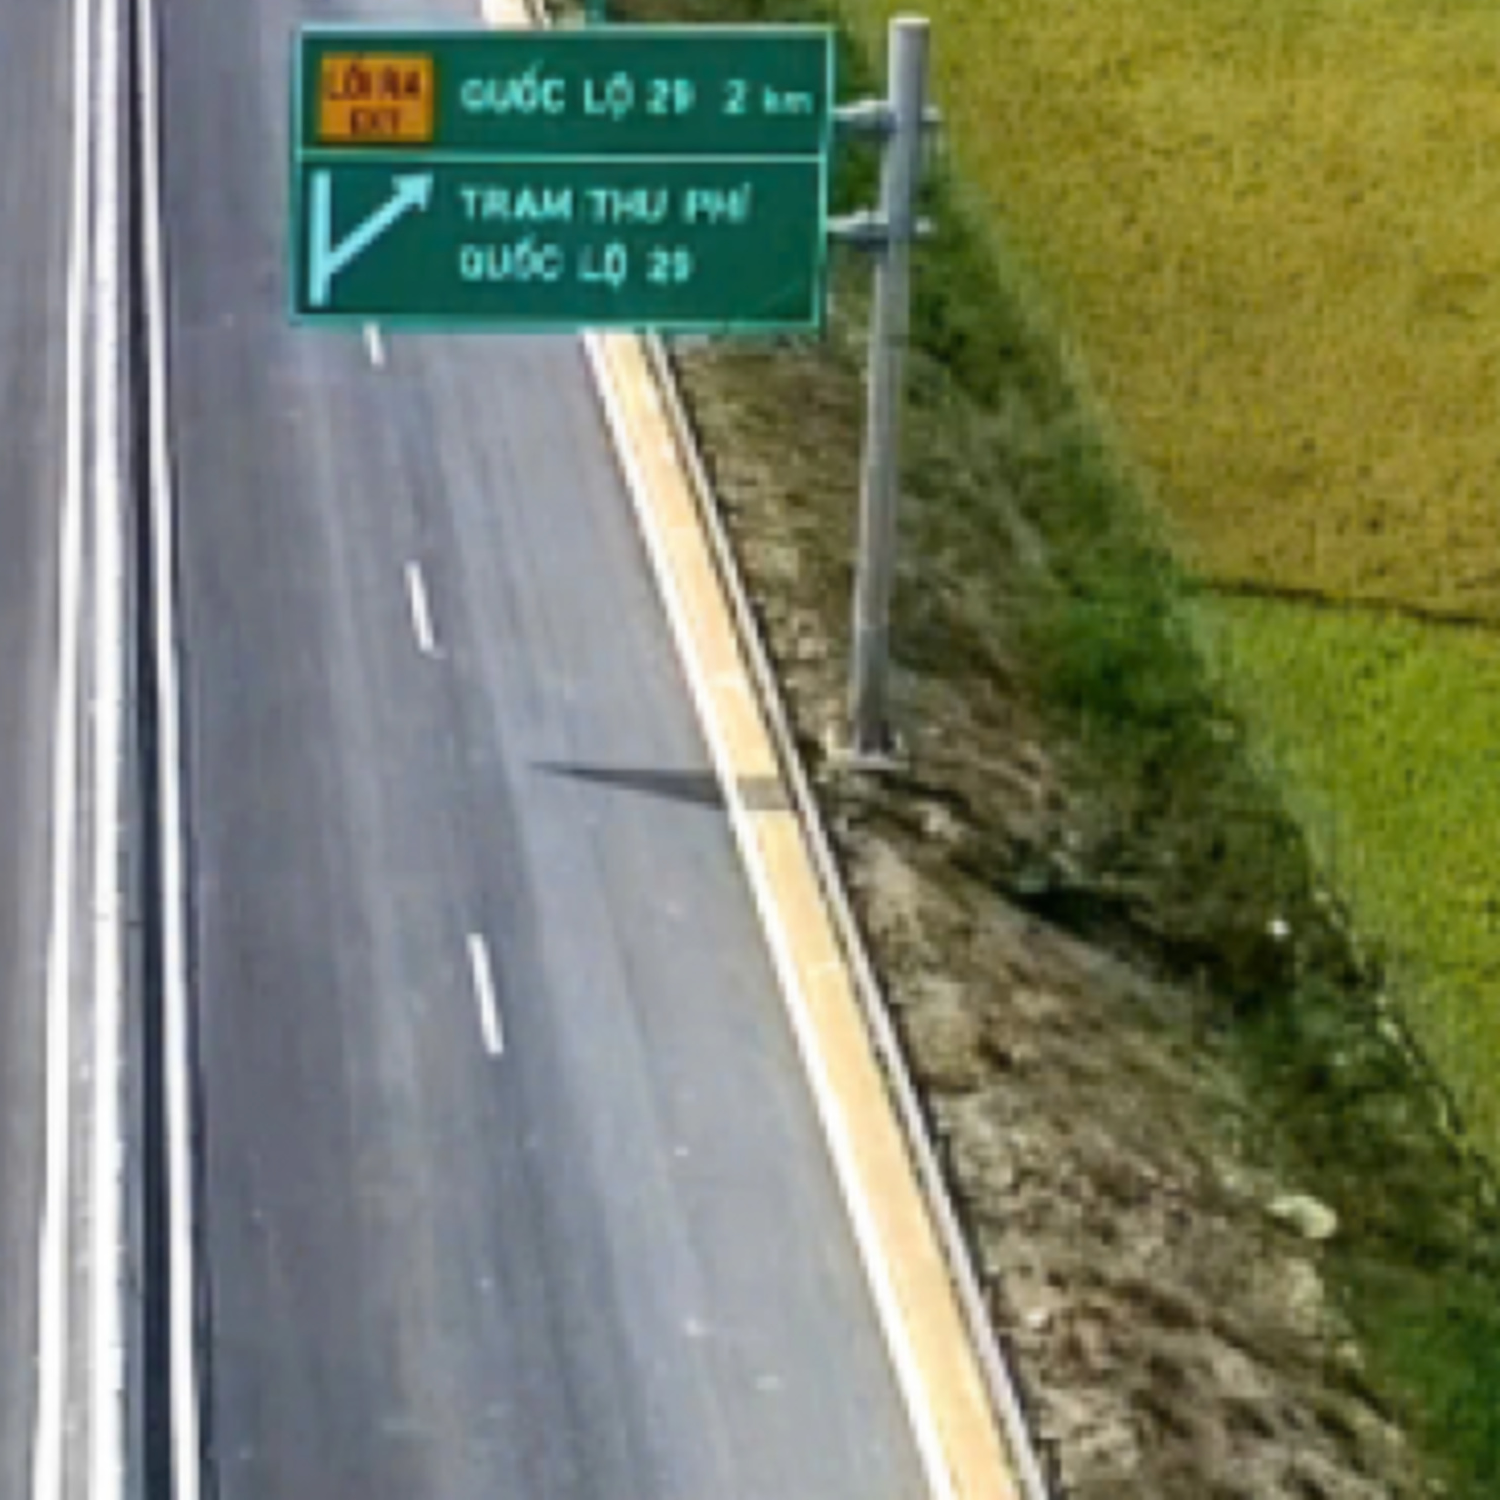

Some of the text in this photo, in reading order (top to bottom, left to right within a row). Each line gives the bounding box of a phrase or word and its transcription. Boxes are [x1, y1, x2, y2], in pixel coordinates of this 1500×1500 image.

[722, 77, 747, 115] 2
[763, 84, 814, 115] km
[584, 188, 668, 224] THU
